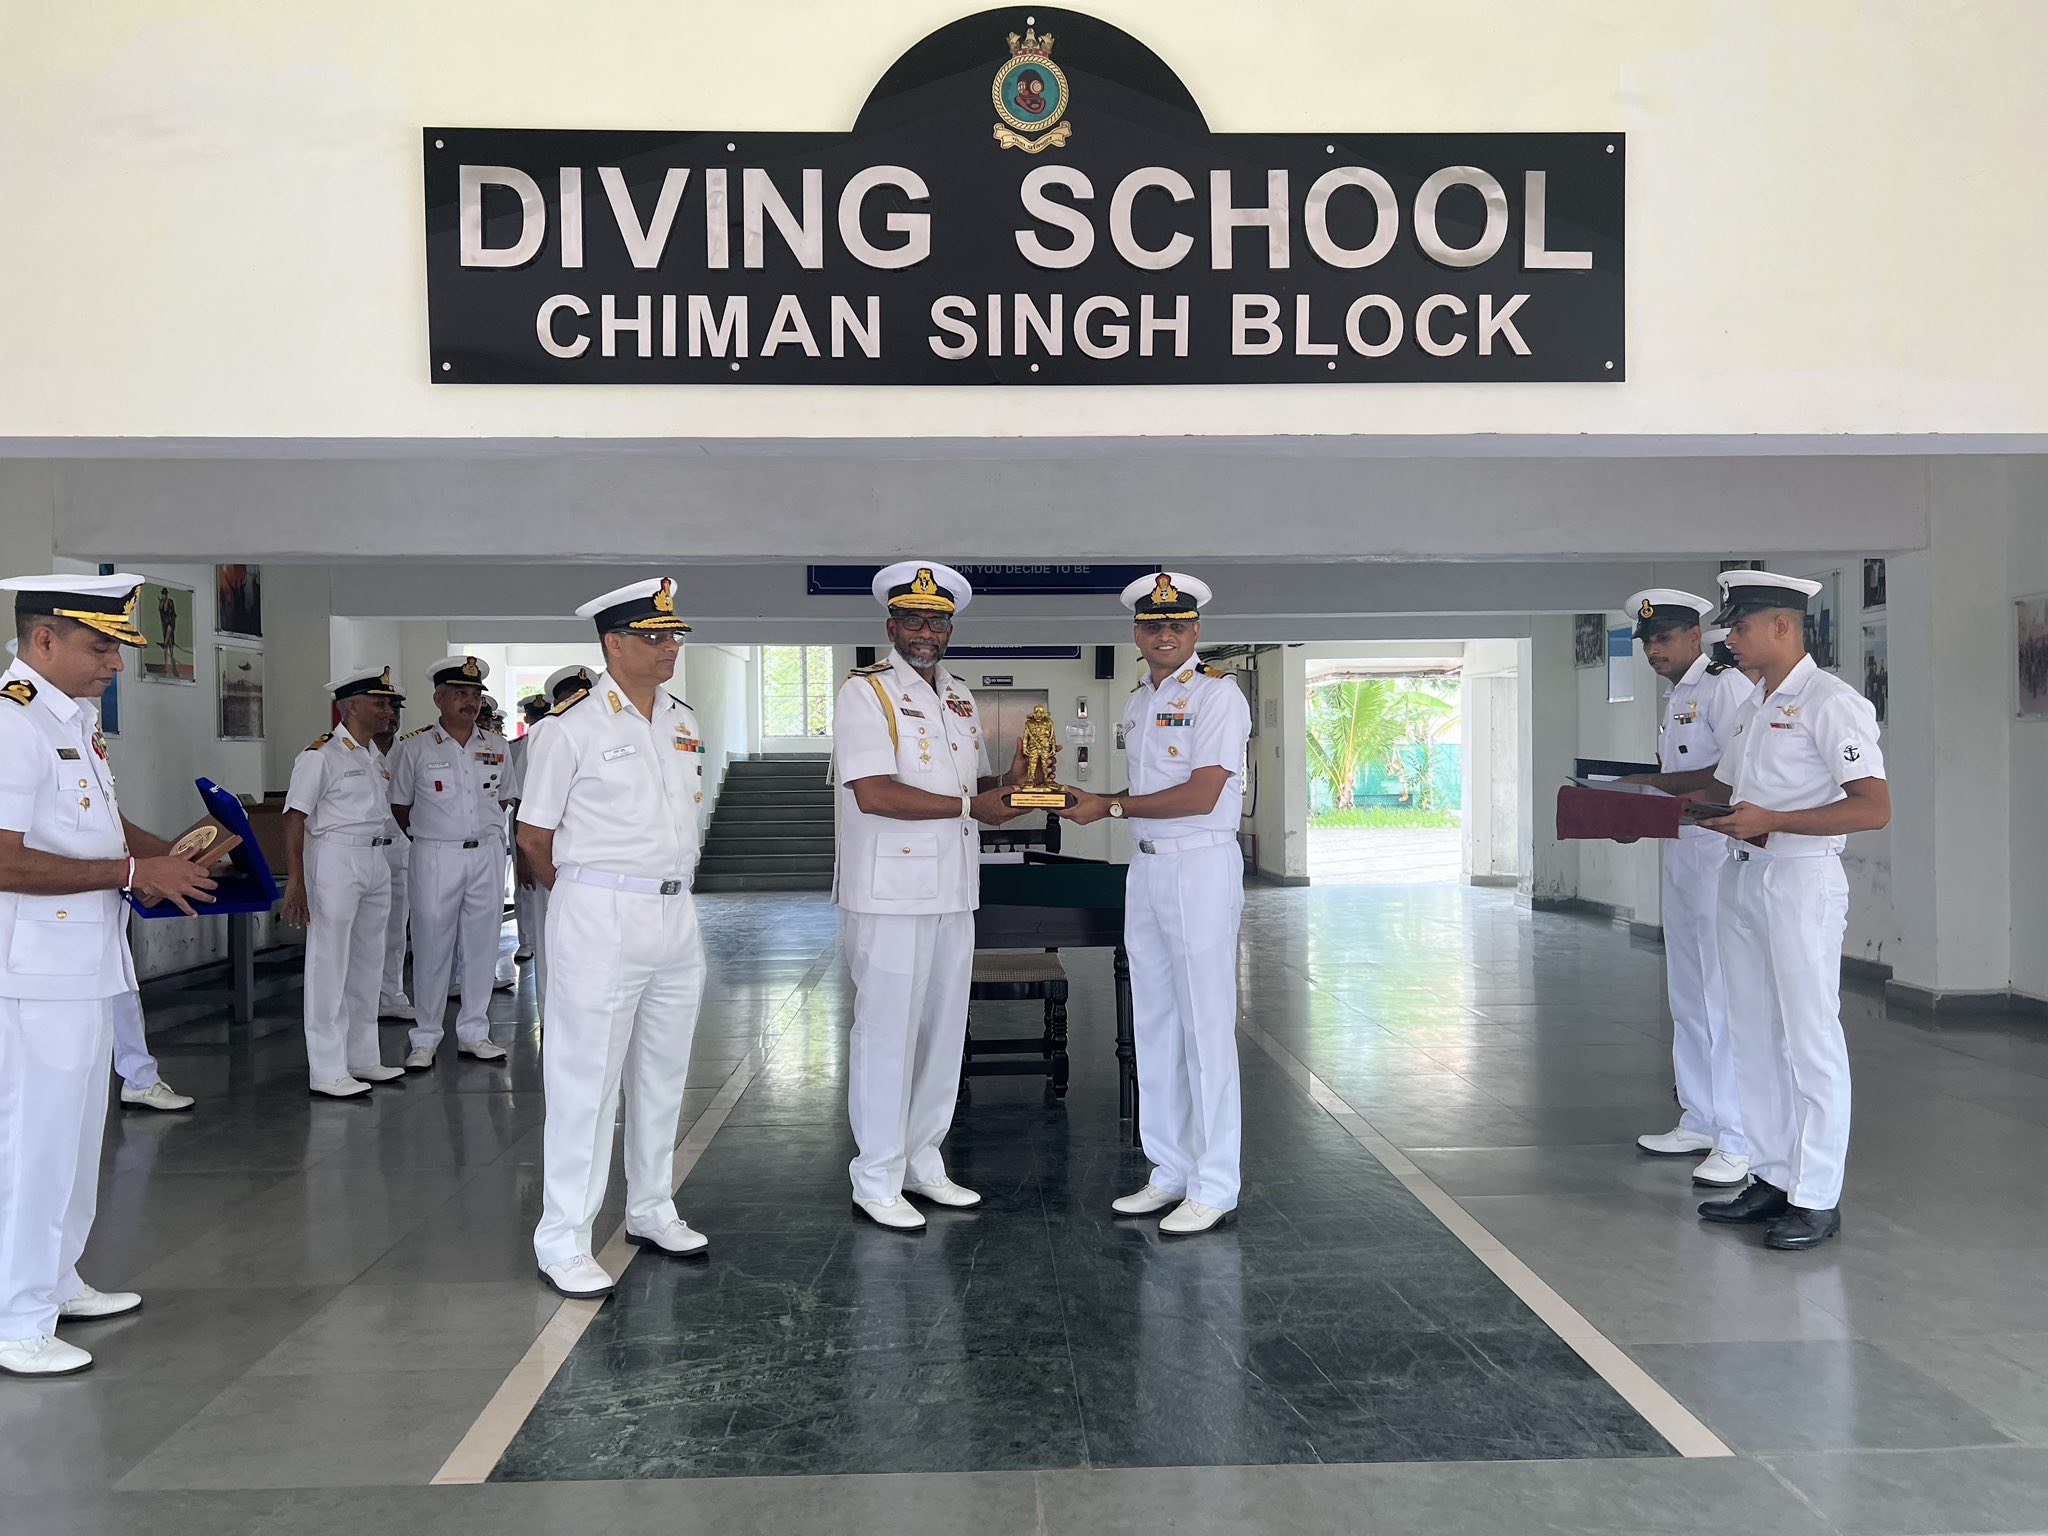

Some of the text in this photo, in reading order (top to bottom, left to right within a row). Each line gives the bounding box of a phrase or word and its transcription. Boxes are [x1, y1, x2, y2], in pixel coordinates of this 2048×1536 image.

[459, 164, 1593, 270] DIVING SCHOOL
[536, 293, 1532, 359] CHIMAN SINGH BLOCK
[977, 565, 1002, 574] YOU
[1005, 565, 1051, 574] DECIDE
[1054, 565, 1070, 574] TO
[1074, 565, 1090, 574] BE
